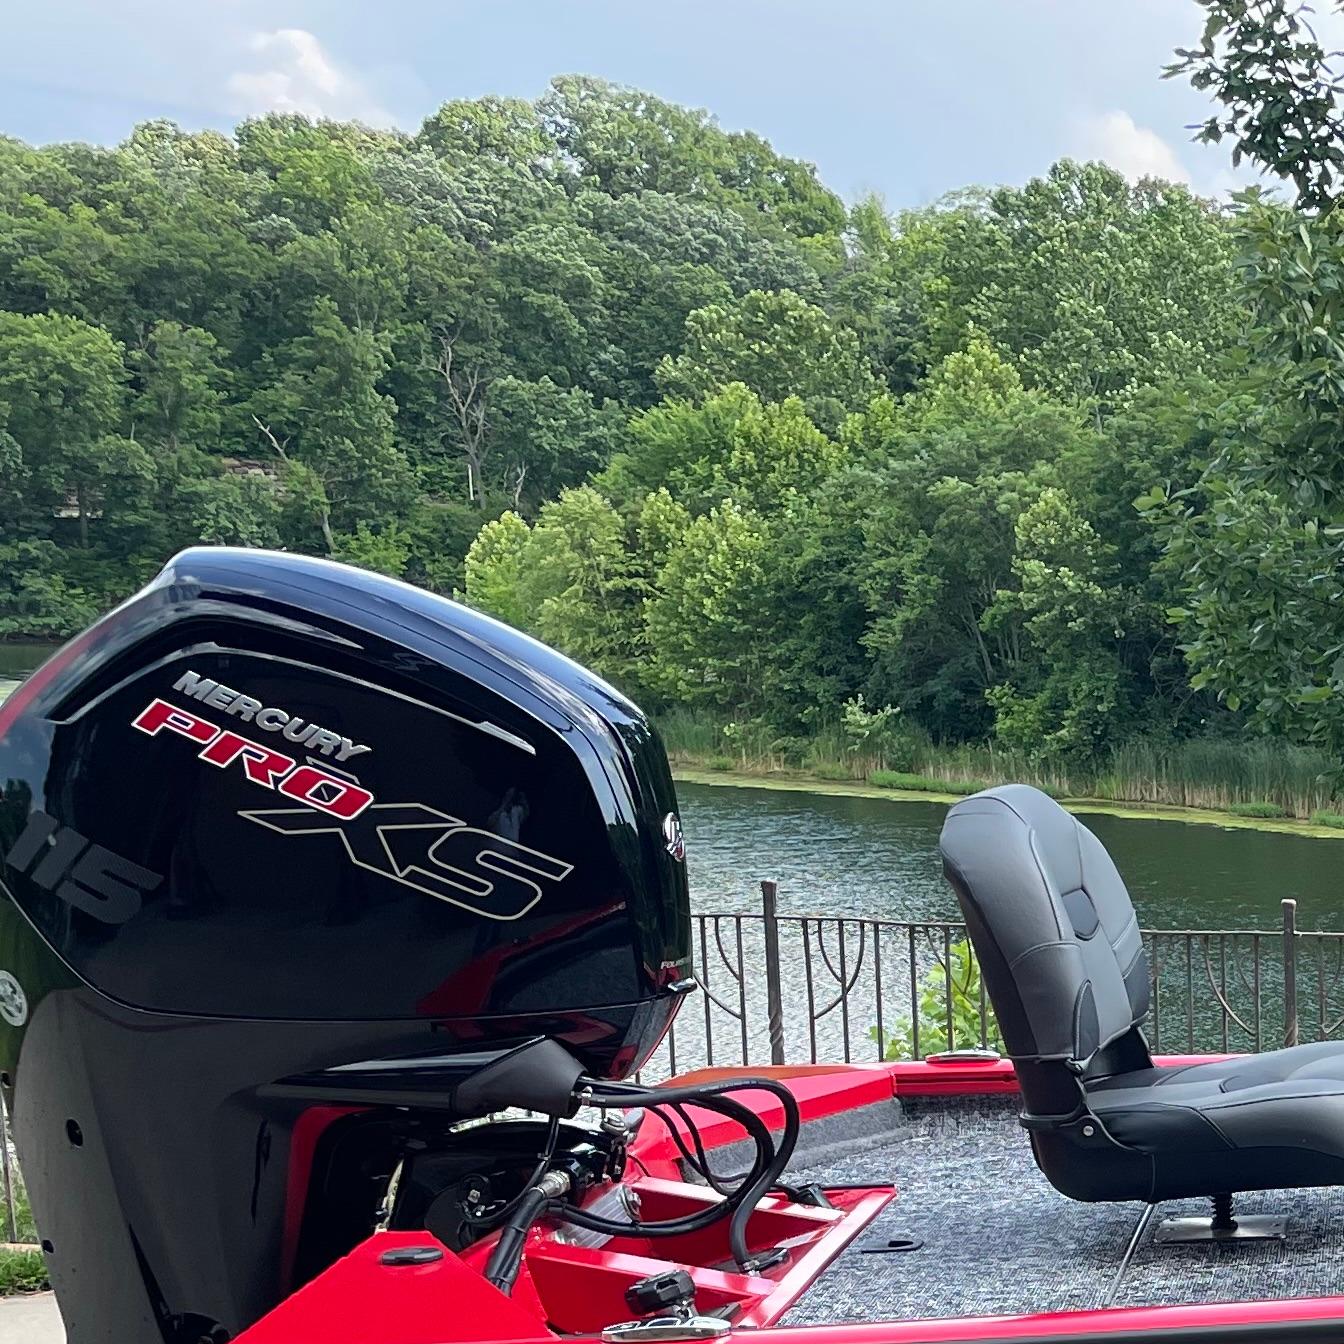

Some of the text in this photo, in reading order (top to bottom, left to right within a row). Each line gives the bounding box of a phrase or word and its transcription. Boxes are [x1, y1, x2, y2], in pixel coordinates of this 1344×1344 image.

[172, 670, 372, 762] MERCURY
[131, 697, 575, 921] PRO XS
[5, 810, 164, 925] 115
